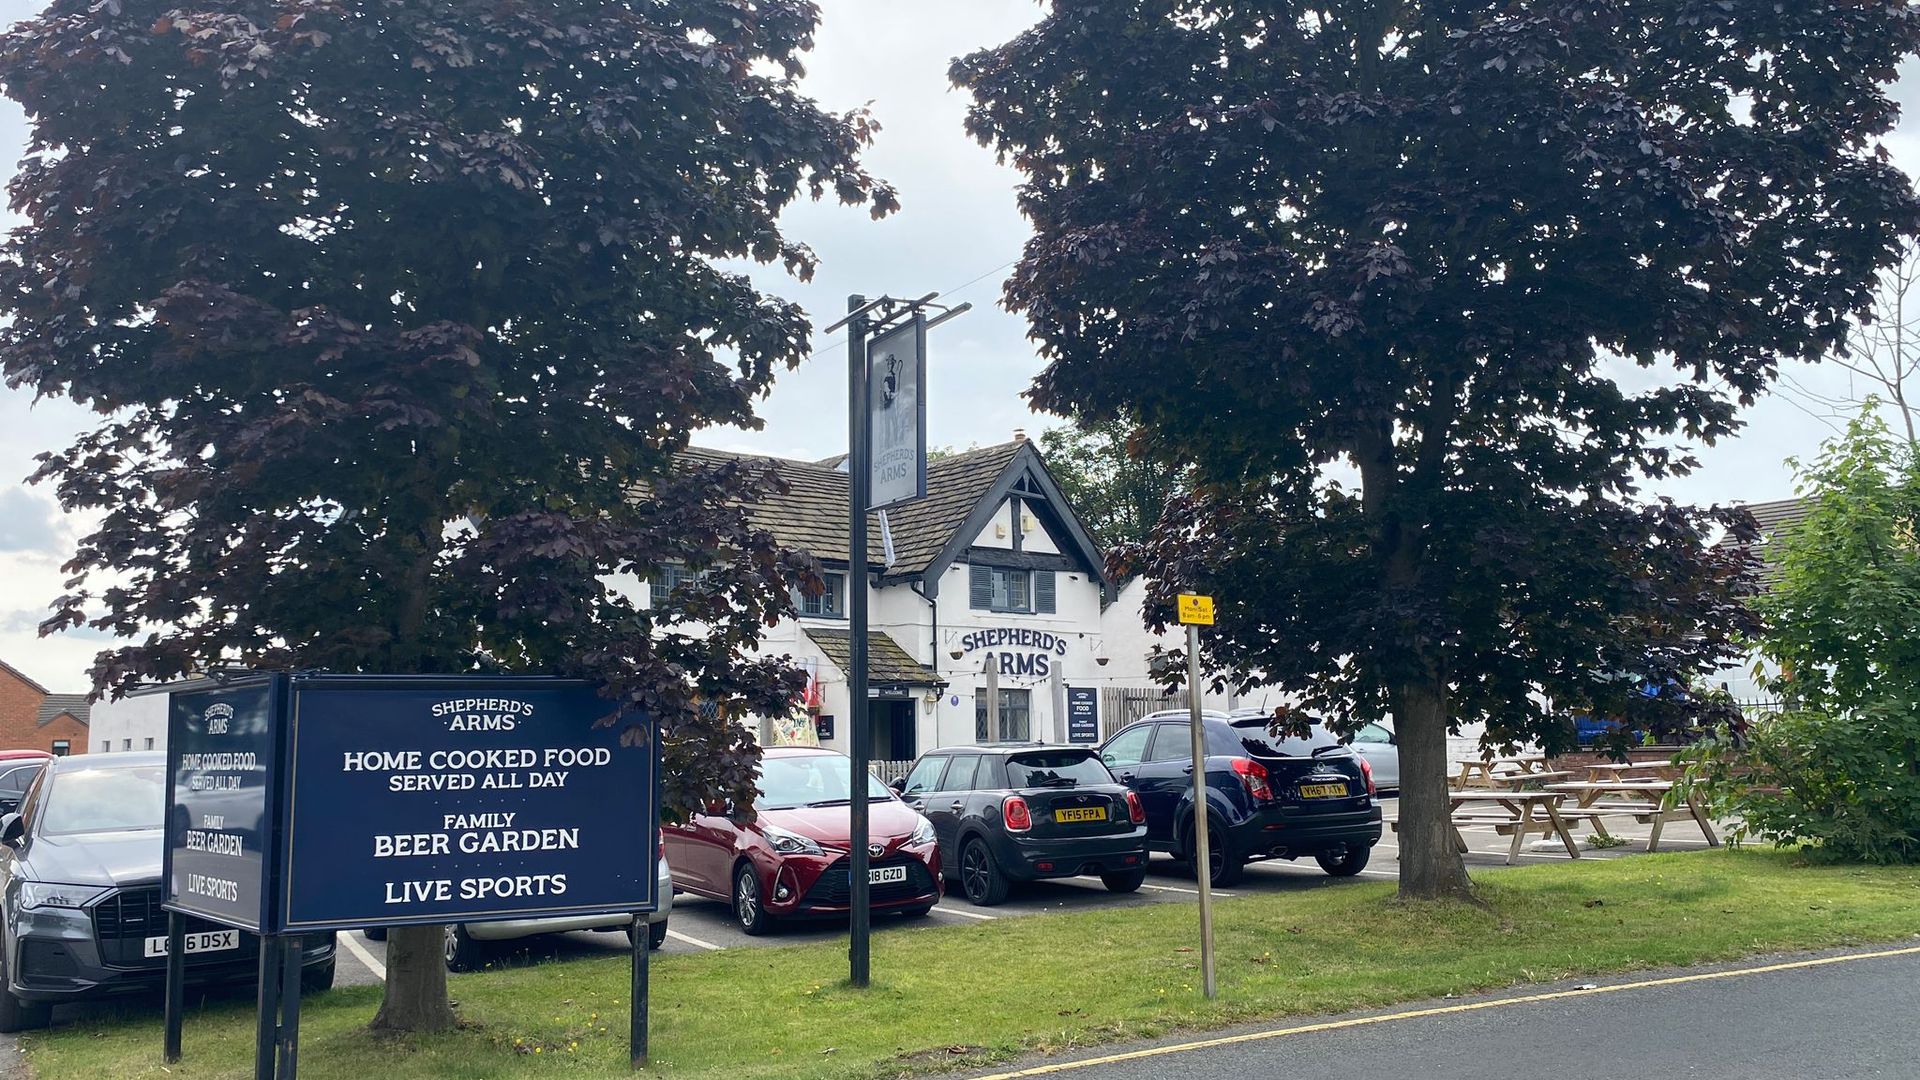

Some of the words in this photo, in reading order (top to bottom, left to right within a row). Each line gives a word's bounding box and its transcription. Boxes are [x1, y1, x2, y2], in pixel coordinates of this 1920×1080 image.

[880, 462, 907, 484] ARMS
[962, 627, 1067, 656] SHEPHERD'S
[431, 699, 533, 717] SHEPHERD'S
[208, 718, 228, 734] ARMS
[449, 715, 515, 731] ARMS
[182, 753, 202, 771] HOME
[203, 752, 232, 770] COOKED
[233, 752, 256, 770] FOOD
[343, 751, 422, 771] HOME
[429, 749, 537, 769] COOKED
[544, 748, 611, 767] FOOD
[192, 775, 214, 790] SERVED
[215, 775, 227, 790] ALL
[228, 775, 241, 791] DAY
[389, 774, 476, 792] SERVED
[481, 773, 522, 789] ALL
[529, 771, 569, 787] DAY
[204, 814, 224, 830] FAMILY
[443, 813, 516, 830] FAMILY
[1084, 809, 1100, 819] FPA
[186, 830, 206, 851] BEER
[207, 832, 243, 856] GARDEN
[374, 834, 451, 857] BEER
[459, 828, 579, 853] GARDEN
[869, 870, 880, 882] 18
[883, 868, 902, 880] GZD
[188, 873, 205, 895] LIVE
[206, 877, 237, 902] SPORTS
[384, 880, 452, 903] LIVE
[459, 874, 566, 899] SPORTS
[200, 932, 232, 949] DSX
